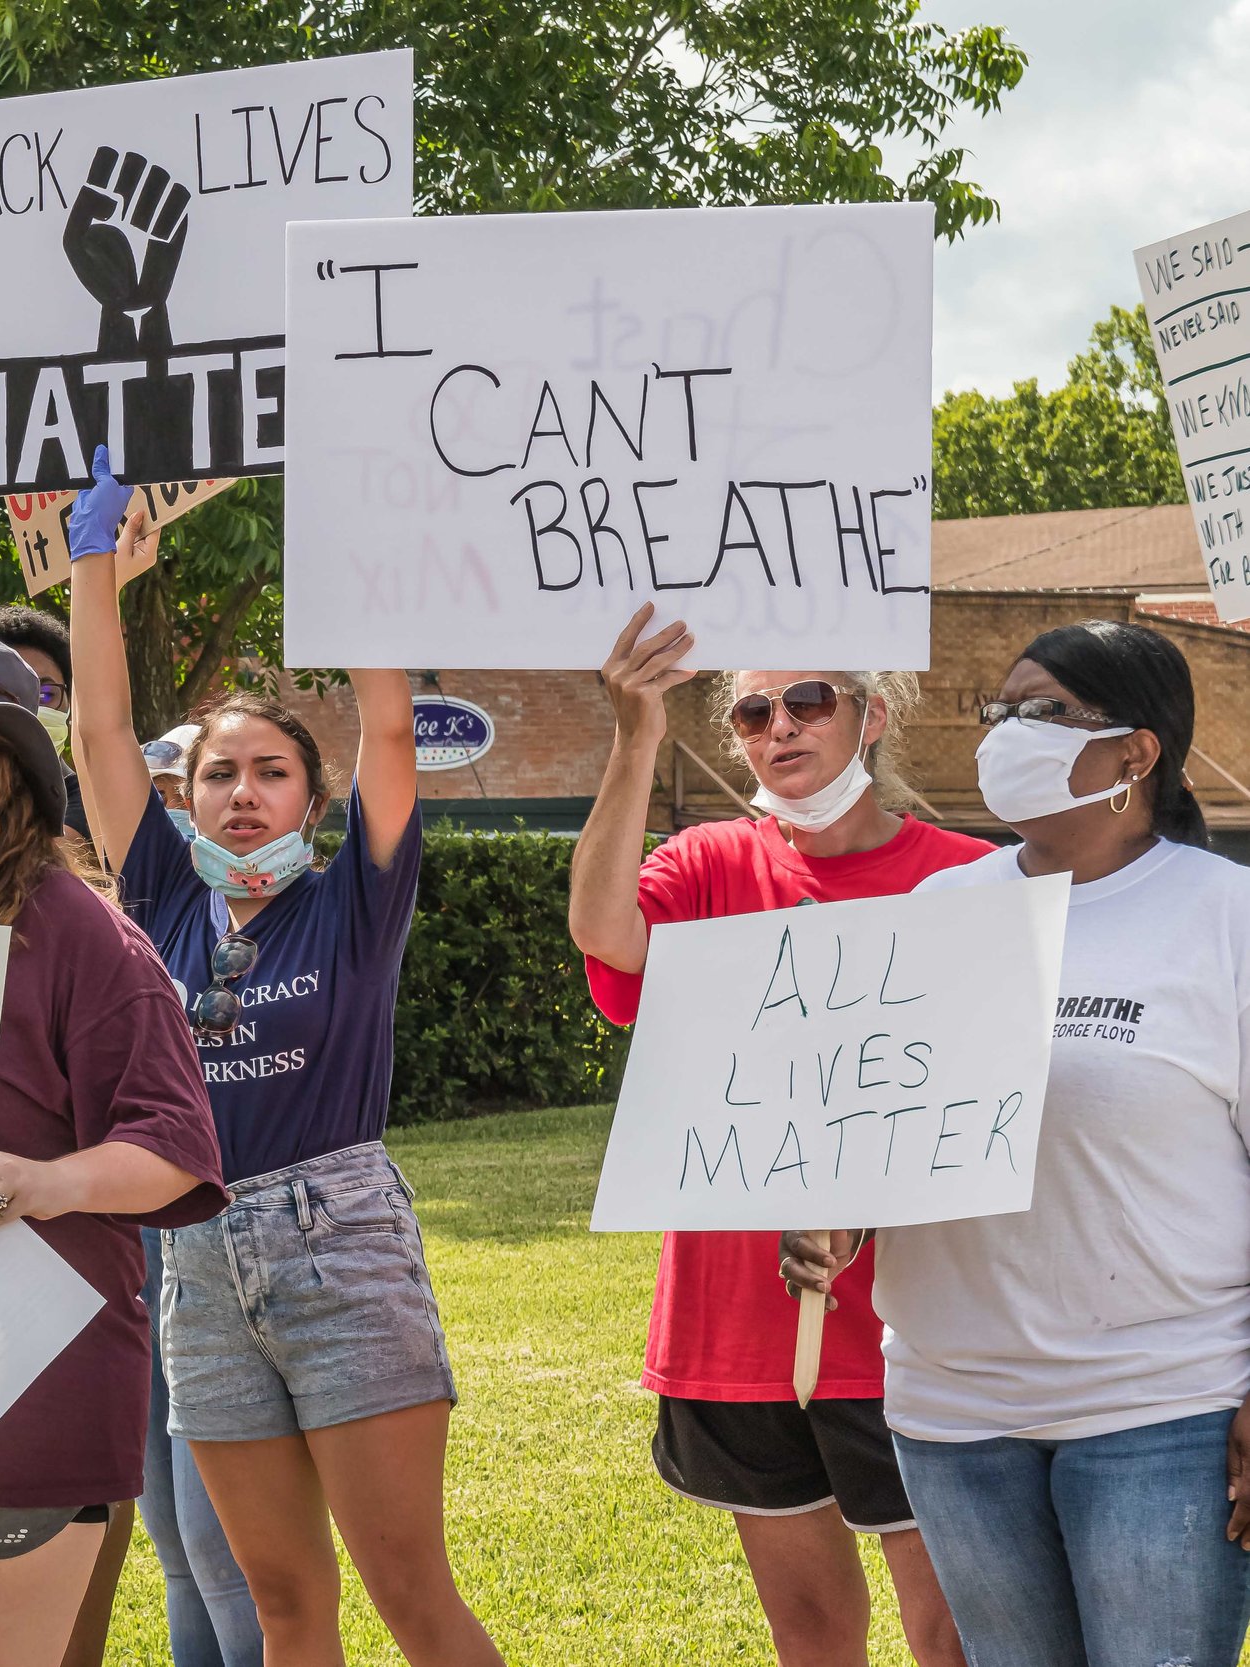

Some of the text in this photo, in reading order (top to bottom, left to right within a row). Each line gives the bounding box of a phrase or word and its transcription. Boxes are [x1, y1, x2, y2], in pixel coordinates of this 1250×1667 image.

[195, 95, 392, 195] LIVES
[1145, 237, 1233, 295] WE SAID
[1158, 301, 1240, 353] NEVER SAID
[430, 362, 733, 477] CAN'T
[1175, 394, 1213, 437] WE
[1190, 466, 1250, 502] WE JUS
[22, 530, 49, 577] it
[510, 475, 931, 596] BREATHE"
[1201, 508, 1243, 550] WITH
[1209, 557, 1235, 589] FOR
[751, 924, 927, 1031] ALL
[231, 1021, 257, 1046] IN
[1052, 1023, 1136, 1044] EORGE FLOYD
[203, 1047, 305, 1082] RKNESS
[725, 1034, 932, 1106] LIVES
[680, 1091, 1023, 1192] MATTER
